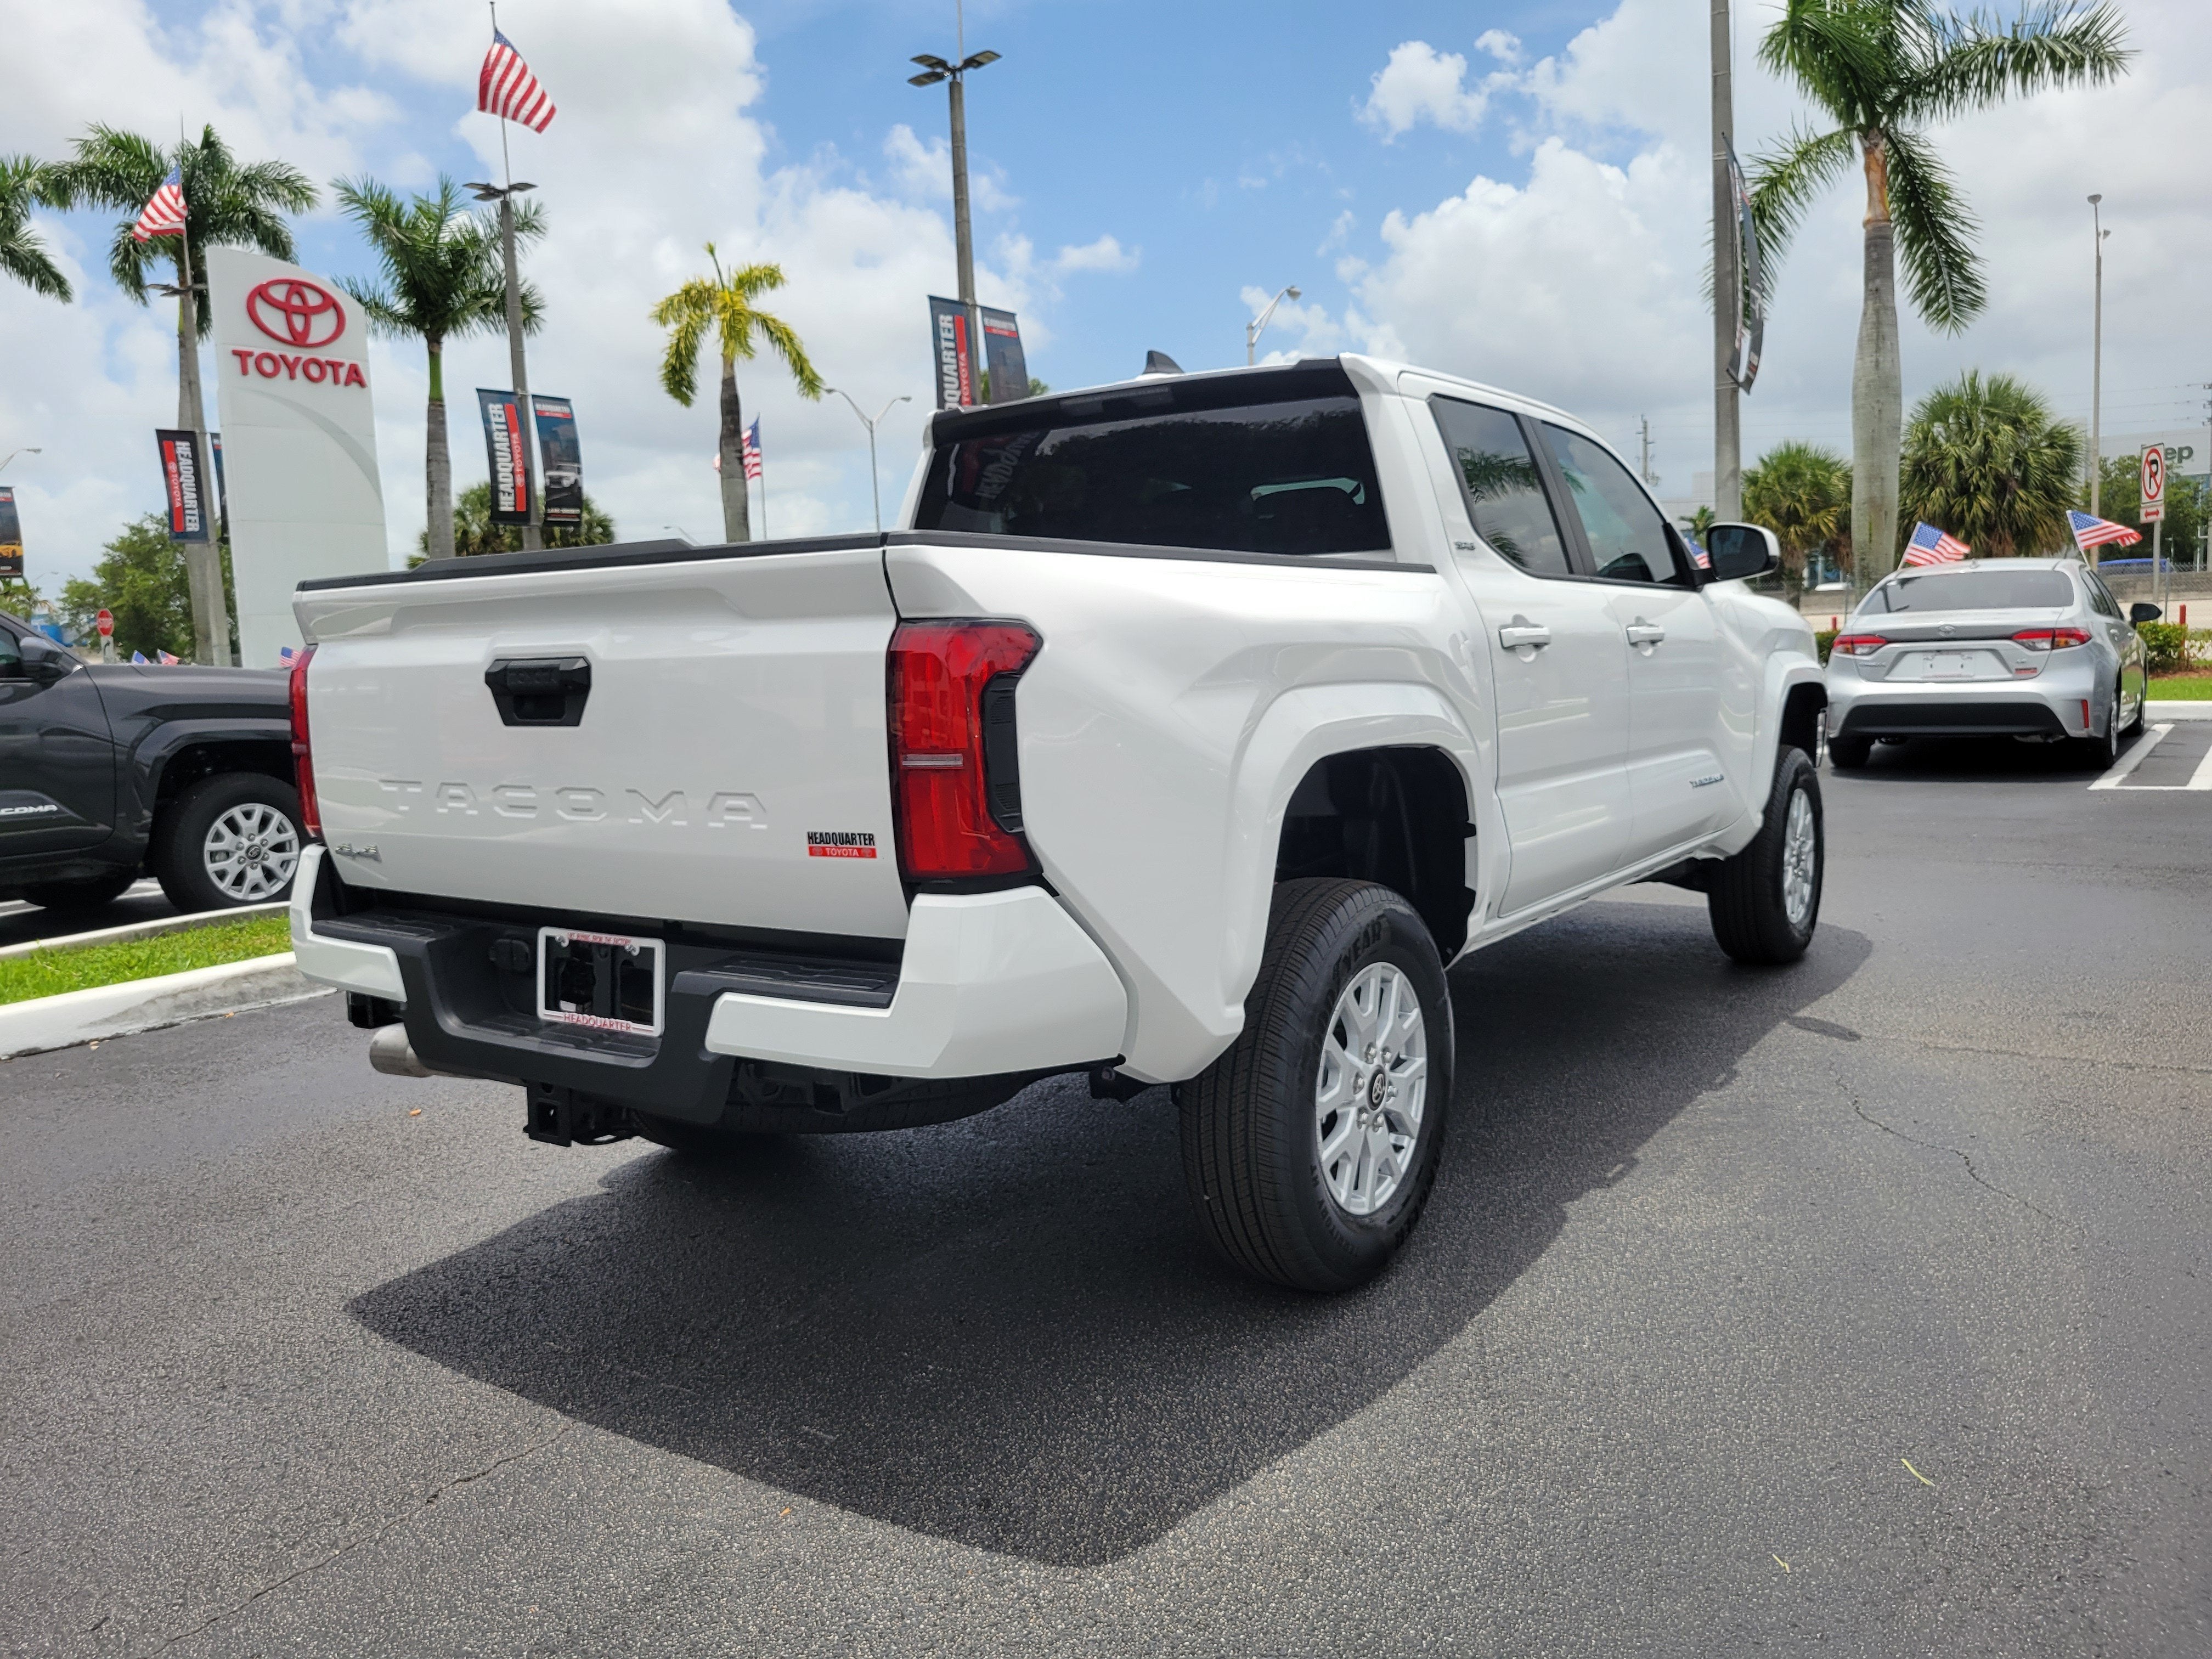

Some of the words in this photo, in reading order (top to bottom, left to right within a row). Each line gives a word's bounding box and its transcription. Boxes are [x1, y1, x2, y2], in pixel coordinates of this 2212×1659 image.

[232, 349, 368, 388] TOYOTA
[488, 403, 515, 512] HEADQUARTER
[2165, 445, 2193, 464] ep
[175, 440, 200, 532] HEADQUARTER
[0, 804, 58, 815] COMA
[379, 779, 768, 830] TACOMA
[807, 831, 876, 846] HEADQUARTER
[825, 848, 859, 856] TOYOTA
[564, 1013, 631, 1031] HEADQUARTER
